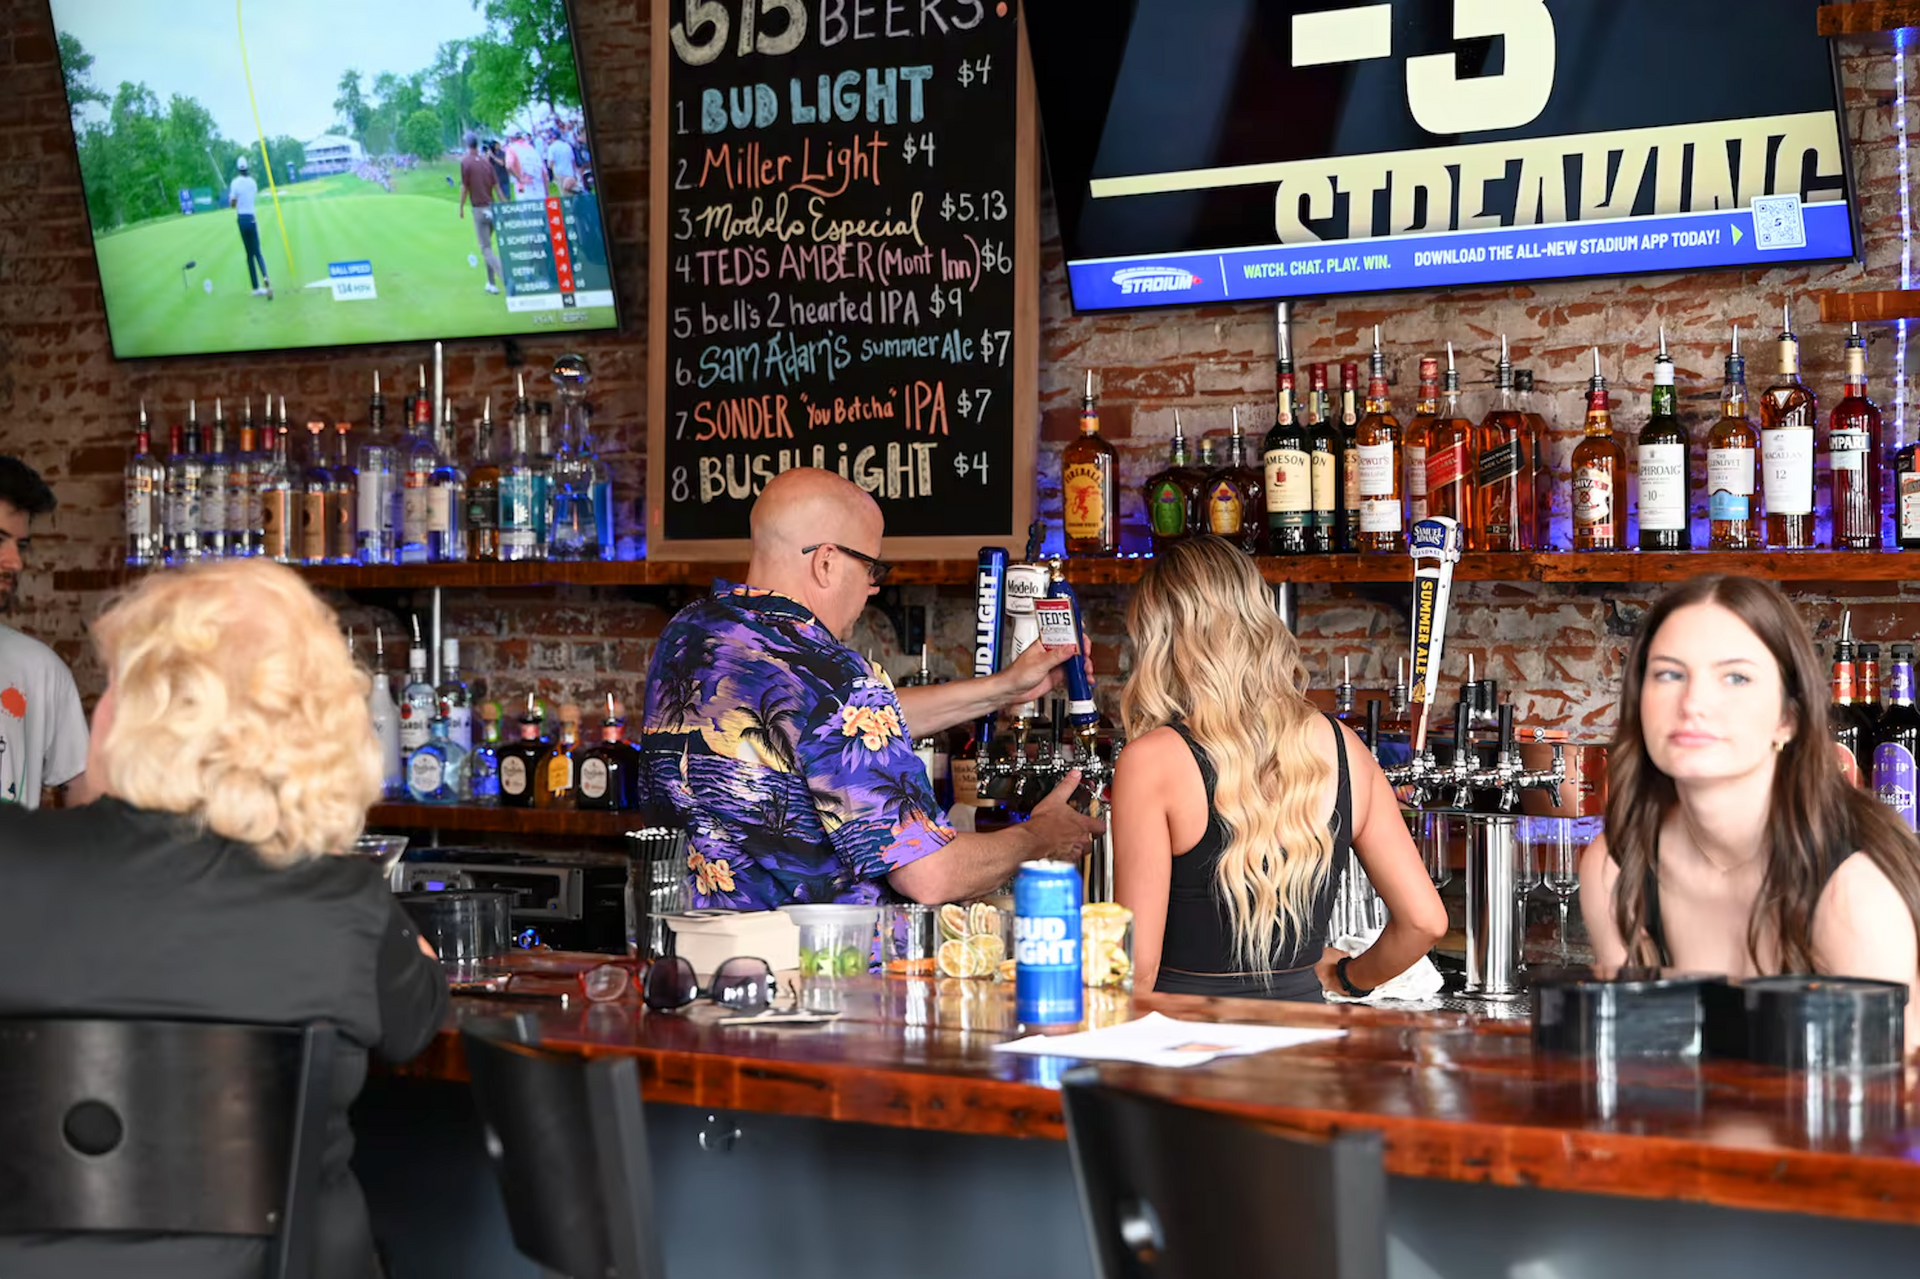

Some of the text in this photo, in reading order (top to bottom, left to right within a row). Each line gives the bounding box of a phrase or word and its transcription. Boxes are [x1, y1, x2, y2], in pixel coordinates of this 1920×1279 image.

[819, 0, 985, 47] BEERS
[702, 83, 778, 134] BUD
[790, 65, 933, 125] LIGHT
[957, 54, 992, 87] $4
[700, 142, 792, 190] Miller
[789, 131, 888, 197] Light
[903, 132, 935, 167] $4
[695, 192, 805, 242] Modelo
[808, 192, 925, 254] Especial
[940, 190, 1008, 222] $5.13
[696, 245, 770, 286] TED'S
[779, 243, 875, 284] AMBER
[981, 238, 1012, 274] $6
[1243, 254, 1391, 279] WATCH. CHAT. PLAY. WIN.
[1414, 229, 1721, 267] DOWNLOAD THE ALL-NEW STADIUM APP TODAY!
[1121, 274, 1193, 294] STADIUM
[702, 299, 761, 335] bell's
[766, 292, 786, 328] 2
[789, 290, 873, 325] hearted
[880, 290, 920, 326] IPA
[929, 284, 963, 319] $9
[698, 341, 760, 388] Sam
[764, 329, 851, 387] Adam's
[860, 332, 941, 362] summer
[941, 328, 974, 363] Ale
[980, 329, 1011, 367] $7
[694, 393, 794, 441] SONDER
[904, 380, 949, 437] IPA
[957, 388, 992, 424] $7
[953, 451, 989, 485] $4
[1775, 470, 1787, 479] 12
[1414, 526, 1444, 537] SAMUEL
[1415, 533, 1440, 545] ADAMS
[977, 572, 997, 643] LIGHT
[1008, 580, 1039, 594] Modelo
[1038, 612, 1071, 626] TED'S
[1415, 581, 1433, 675] SUMMER ALE
